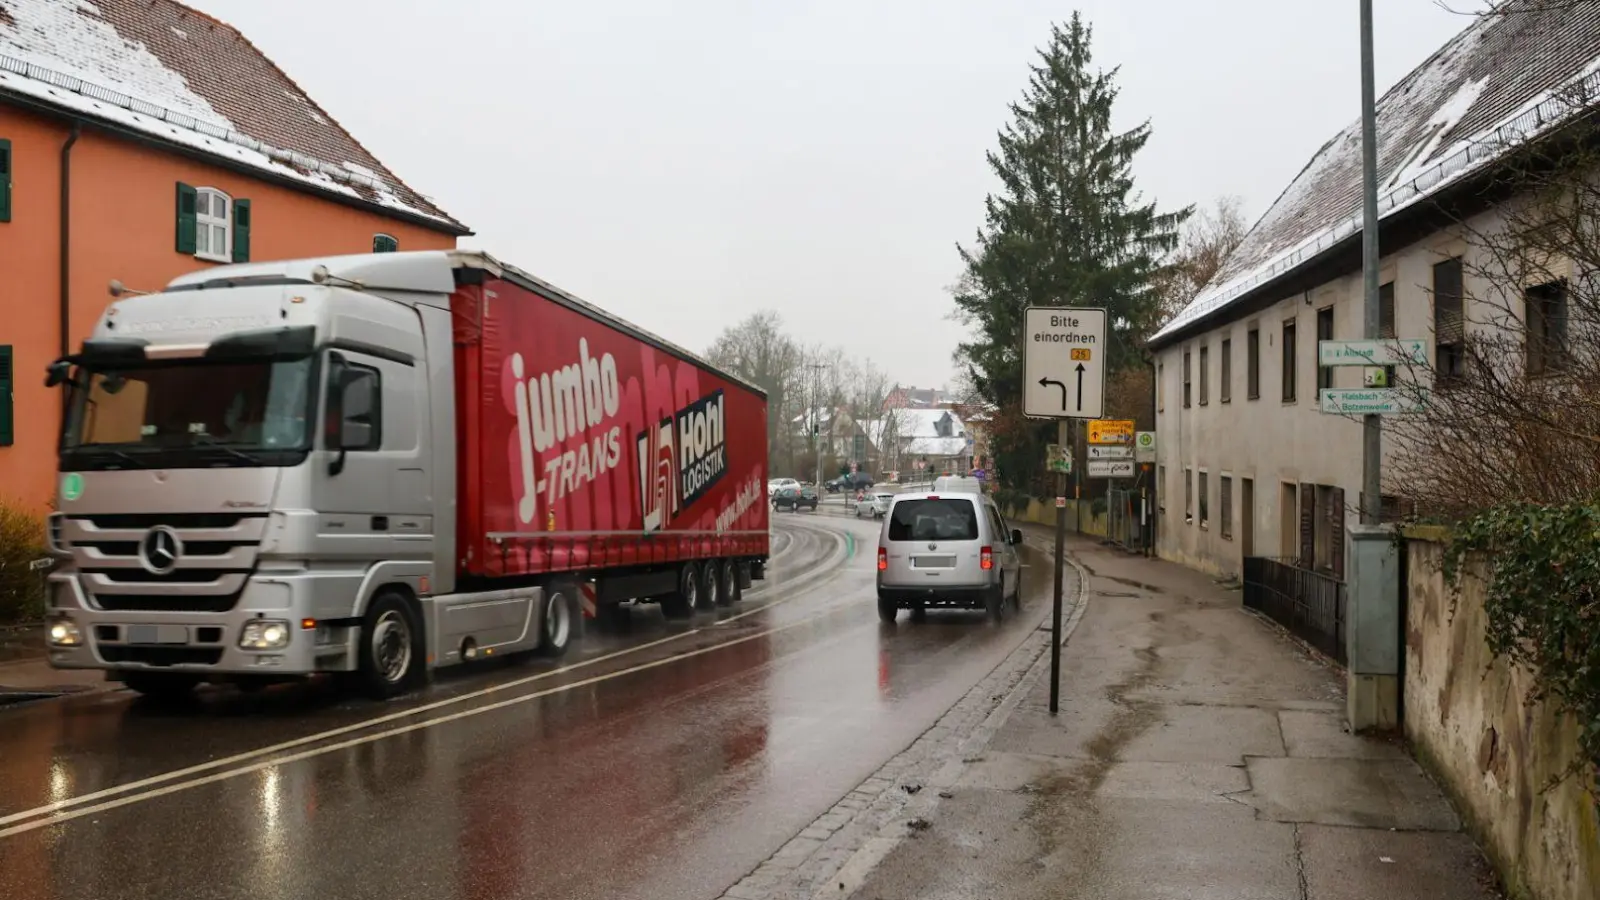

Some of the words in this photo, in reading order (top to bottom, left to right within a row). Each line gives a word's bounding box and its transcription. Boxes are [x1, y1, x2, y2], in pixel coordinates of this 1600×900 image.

[1050, 315, 1079, 328] Bitte
[1034, 331, 1096, 343] einordnen
[1074, 350, 1086, 360] 25
[1341, 392, 1378, 402] Halsbach
[1341, 402, 1393, 412] Botzenweiler
[511, 336, 620, 524] jumbo
[682, 445, 725, 501] LOGISTIK
